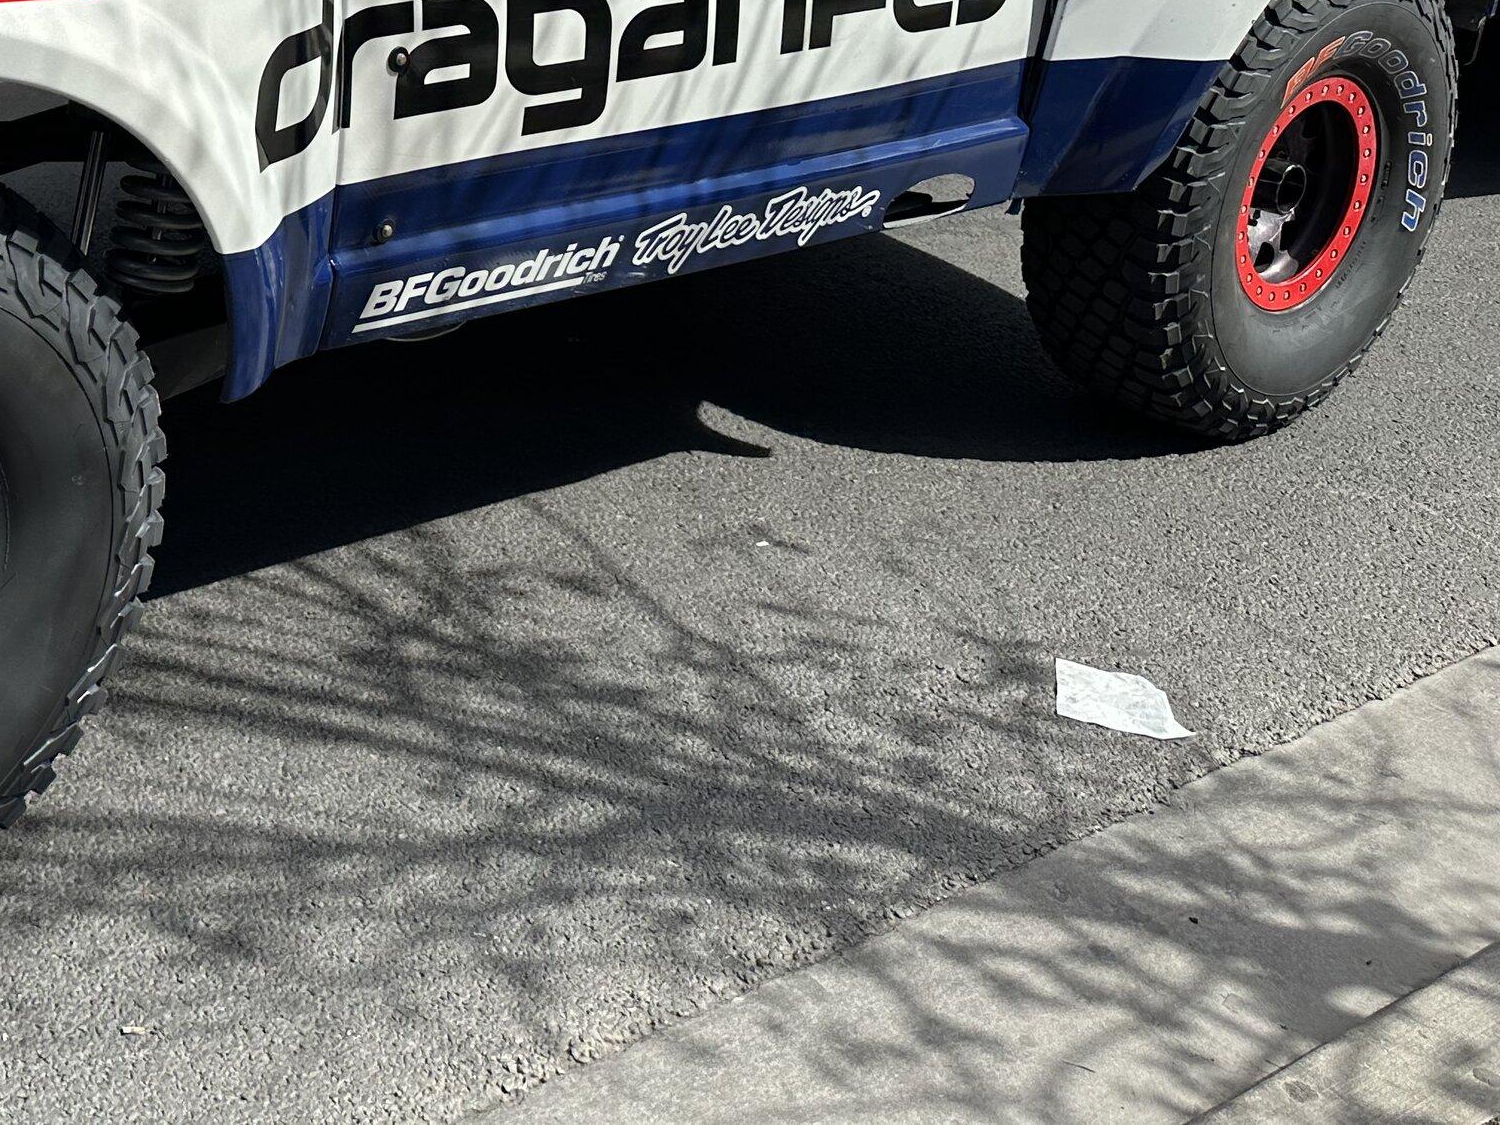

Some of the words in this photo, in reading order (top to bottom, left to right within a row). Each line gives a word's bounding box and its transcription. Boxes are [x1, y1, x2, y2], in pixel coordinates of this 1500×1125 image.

[694, 205, 757, 256] Lee
[756, 186, 880, 246] Designs
[359, 235, 621, 319] BFGoodrich
